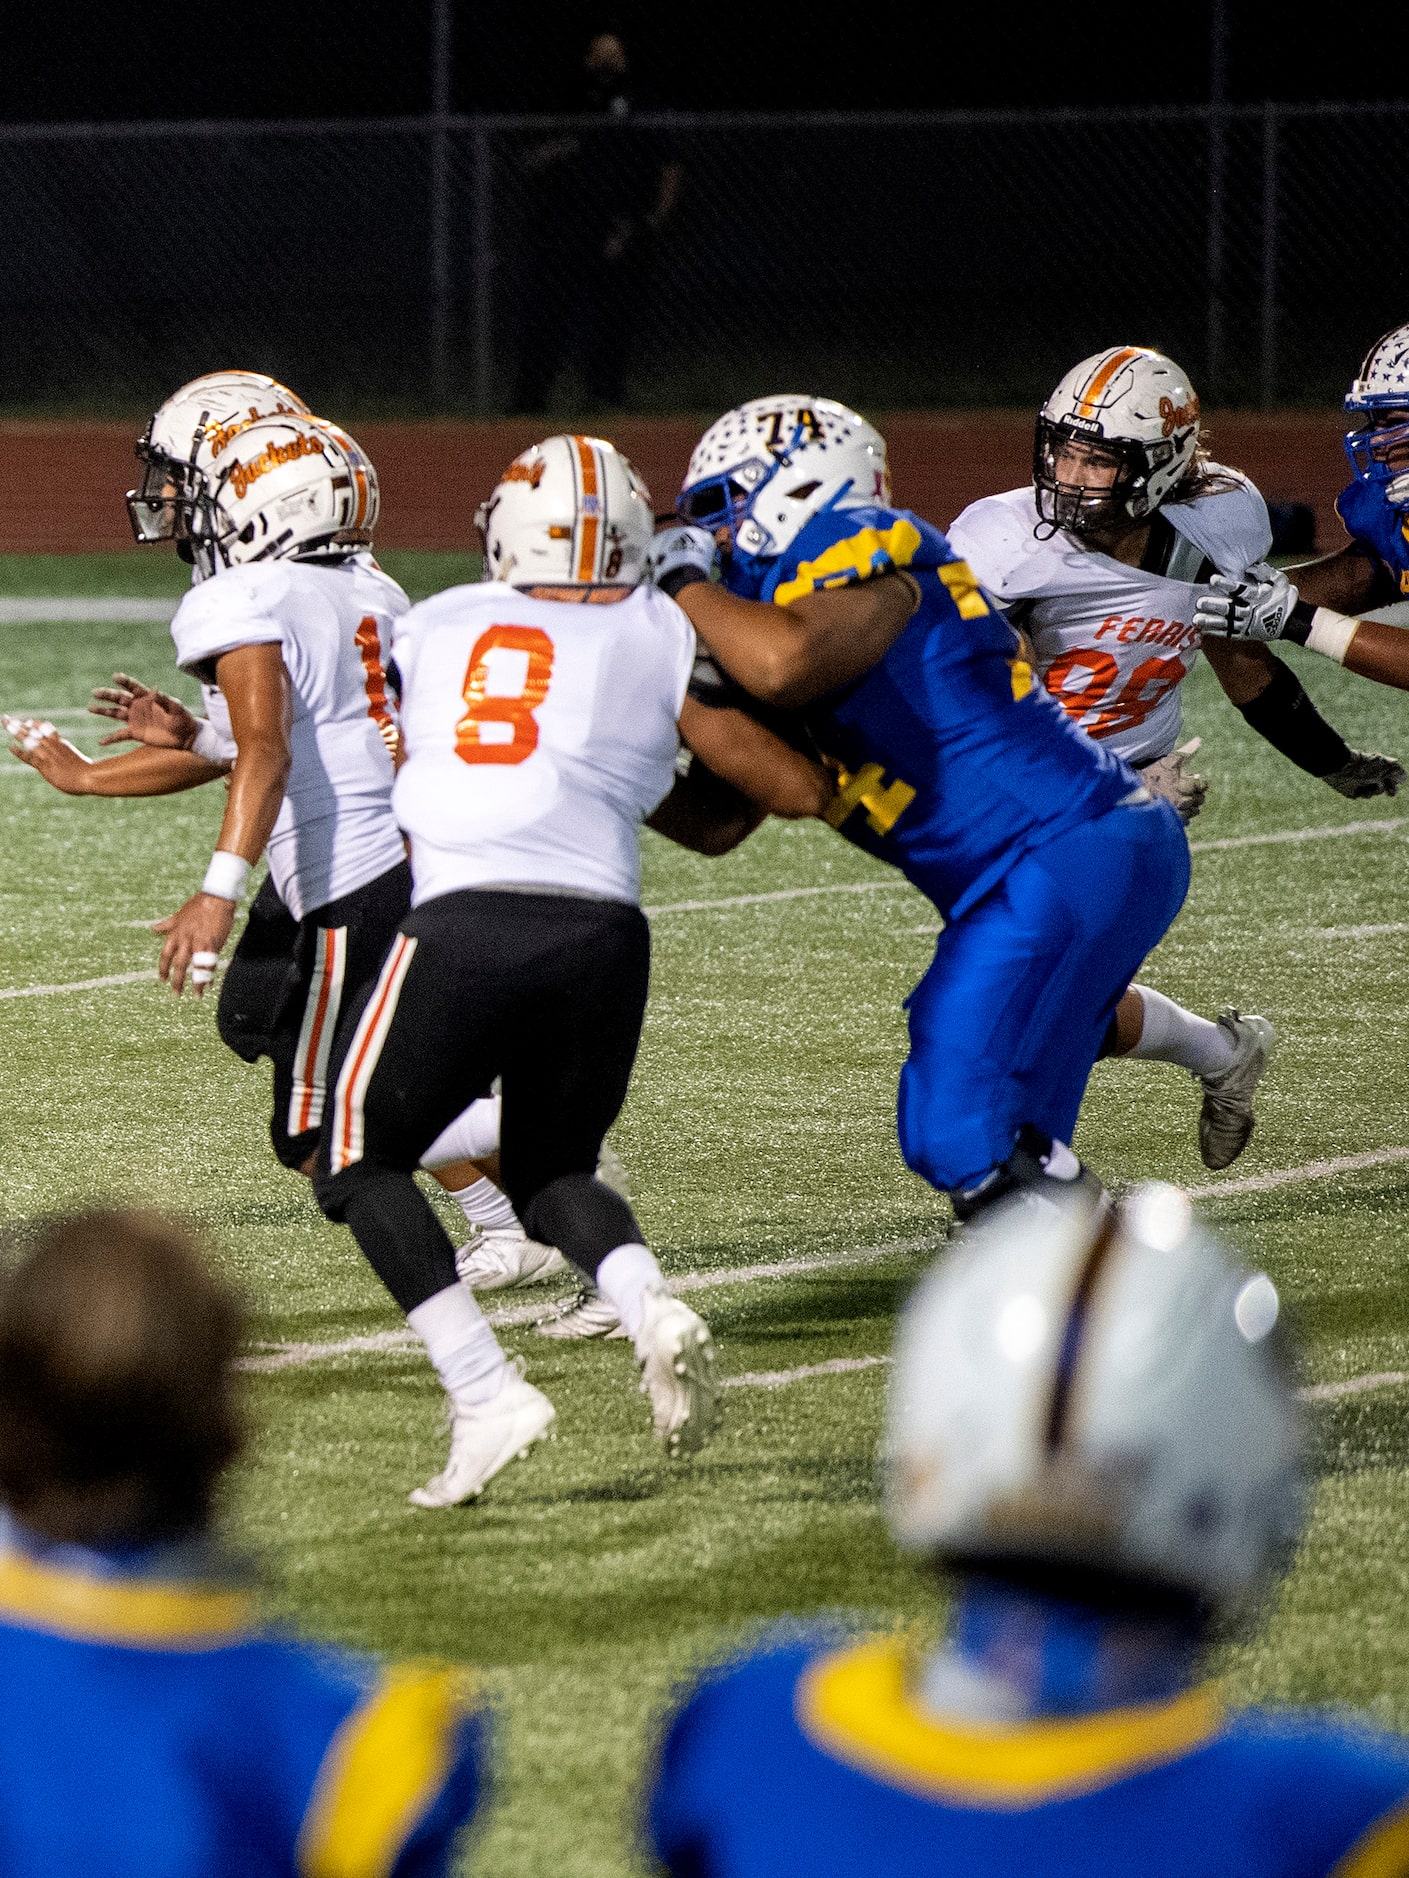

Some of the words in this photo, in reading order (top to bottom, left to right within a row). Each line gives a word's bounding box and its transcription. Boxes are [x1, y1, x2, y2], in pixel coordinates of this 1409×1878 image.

[1063, 415, 1099, 433] Riddell
[1094, 615, 1204, 651] FERRIS
[454, 623, 555, 765] 8
